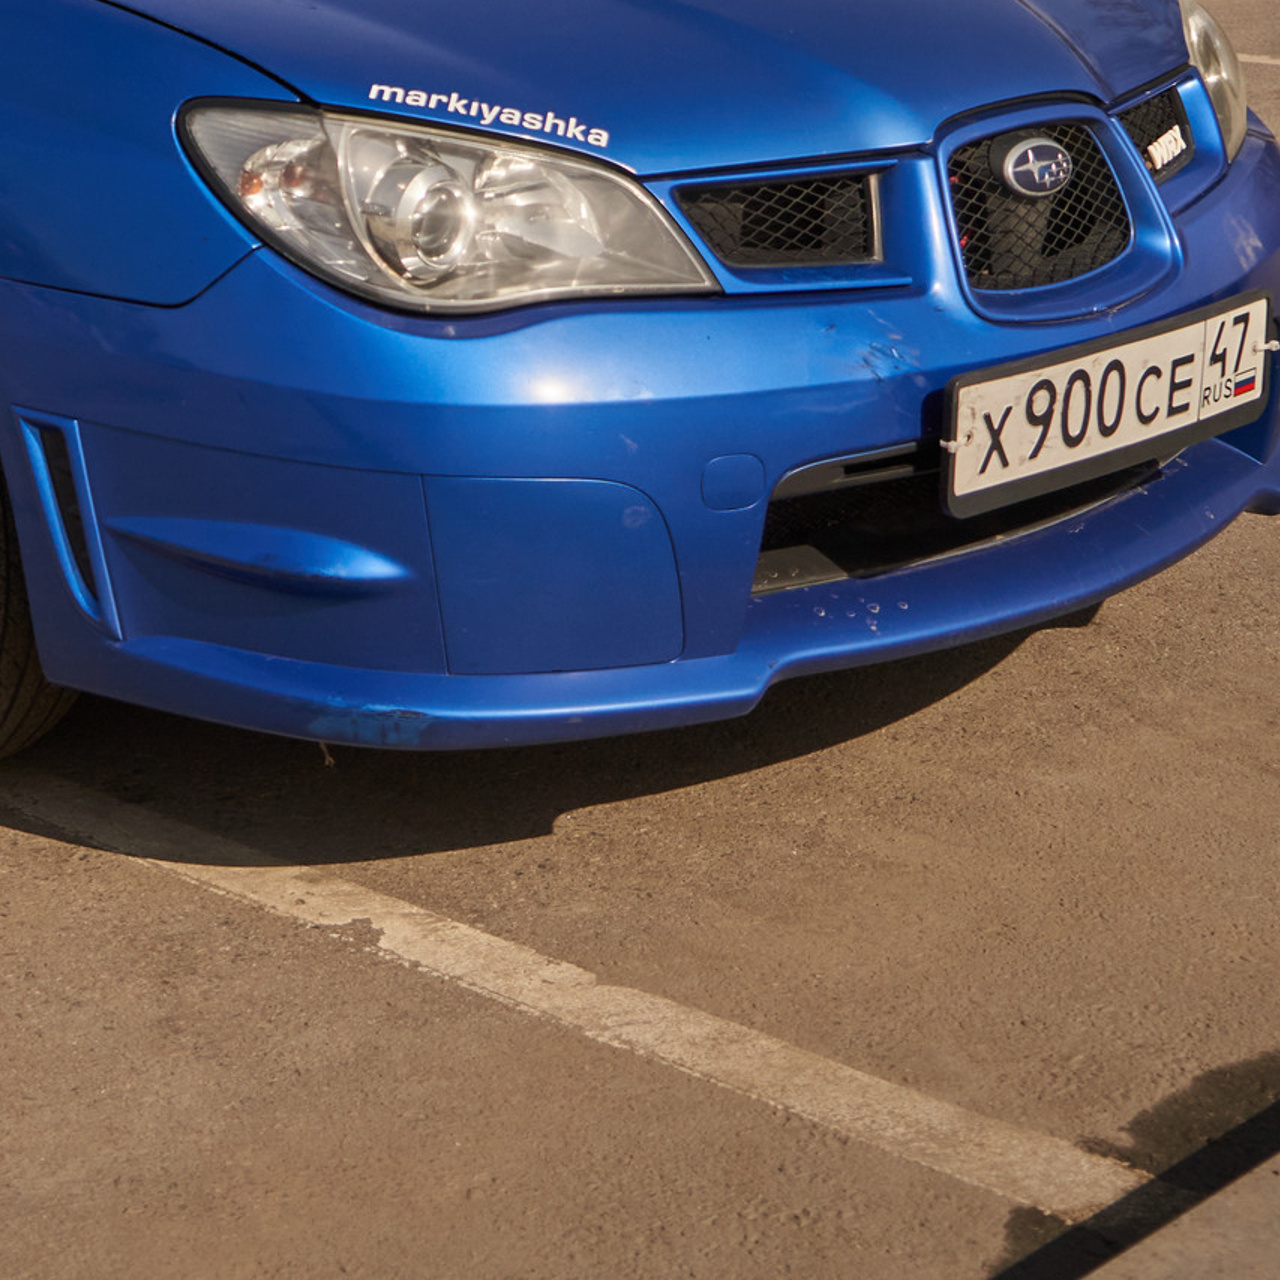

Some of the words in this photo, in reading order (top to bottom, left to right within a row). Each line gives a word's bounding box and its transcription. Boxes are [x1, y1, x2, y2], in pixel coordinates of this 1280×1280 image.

[368, 83, 610, 148] markiyashka
[1209, 311, 1251, 379] 47
[1202, 376, 1233, 407] RUS
